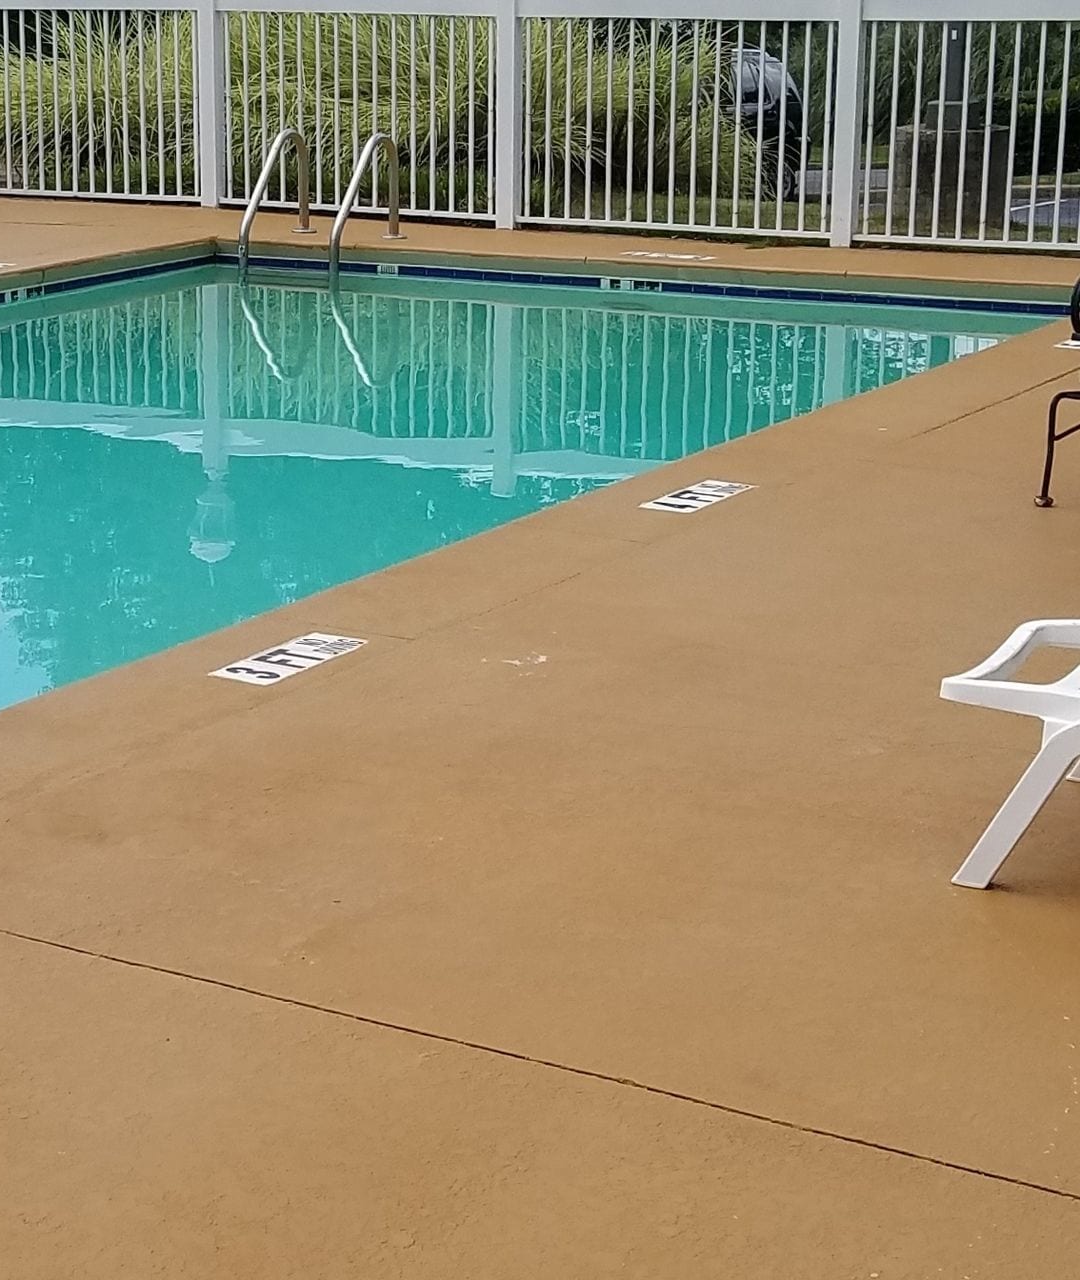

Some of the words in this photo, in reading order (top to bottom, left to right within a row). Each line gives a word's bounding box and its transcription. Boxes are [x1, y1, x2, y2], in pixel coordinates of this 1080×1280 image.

[667, 489, 725, 503] FT
[251, 648, 325, 669] FT
[225, 666, 281, 680] 3
